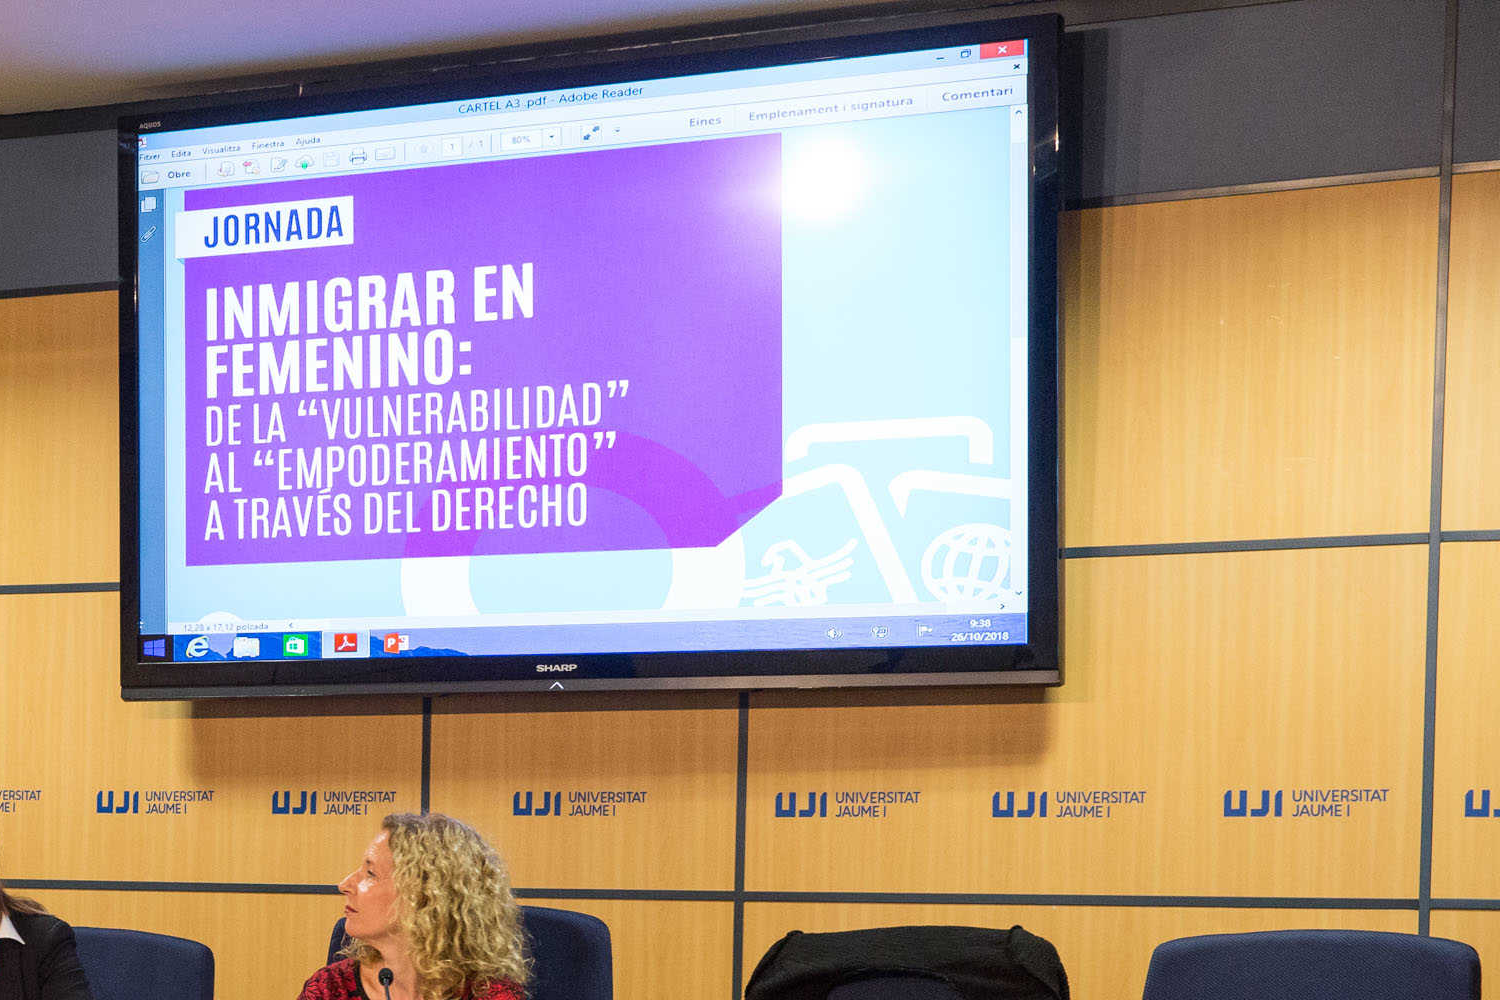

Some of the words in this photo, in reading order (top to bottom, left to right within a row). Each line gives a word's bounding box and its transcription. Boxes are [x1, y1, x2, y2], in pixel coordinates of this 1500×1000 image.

[458, 101, 501, 114] CARTEL
[505, 98, 520, 109] A3
[559, 91, 598, 104] Adobe
[602, 86, 643, 99] Reader
[942, 86, 1013, 102] Comentari
[749, 104, 838, 121] Emplenament
[851, 96, 914, 114] signatura
[689, 116, 722, 127] Eines
[252, 140, 285, 149] Finestra
[295, 136, 321, 146] Ajuda
[168, 170, 191, 179] Obre
[204, 205, 343, 248] JORNADA
[206, 268, 455, 341] INMIGRAR
[473, 263, 534, 322] EN
[206, 329, 472, 398] FEMENINO:
[206, 404, 241, 447] DE
[253, 402, 286, 444] LA
[297, 380, 630, 440] “VULNERABILIDAD”
[204, 451, 242, 494] AL
[254, 432, 617, 491] “EMPODERAMIENTO”
[204, 500, 224, 541] A
[236, 488, 352, 540] TRAVÉS
[365, 494, 420, 535] DEL
[431, 482, 588, 532] DERECHO
[951, 632, 1009, 641] 26/10/2018
[536, 664, 578, 672] SHARP
[96, 790, 139, 814] UJI
[145, 790, 215, 802] UNIVERSITAT
[323, 791, 397, 802] UNIVERSITAT
[568, 791, 647, 803] UNIVERSITAT
[835, 792, 920, 804] UNIVERSITAT
[1056, 791, 1147, 804] UNIVERSITAT
[1292, 789, 1389, 802] UNIVERSITAT
[145, 803, 182, 814] JAUME
[271, 790, 317, 815] UJI
[513, 791, 562, 816] UJI
[775, 792, 827, 818] UJI
[992, 791, 1047, 818] UJI
[1224, 790, 1282, 817] UJI
[323, 804, 362, 815] JAUME
[568, 805, 610, 817] JAUME
[835, 805, 881, 818] JAUME
[1056, 805, 1103, 818] JAUME
[1292, 804, 1343, 817] JAUME
